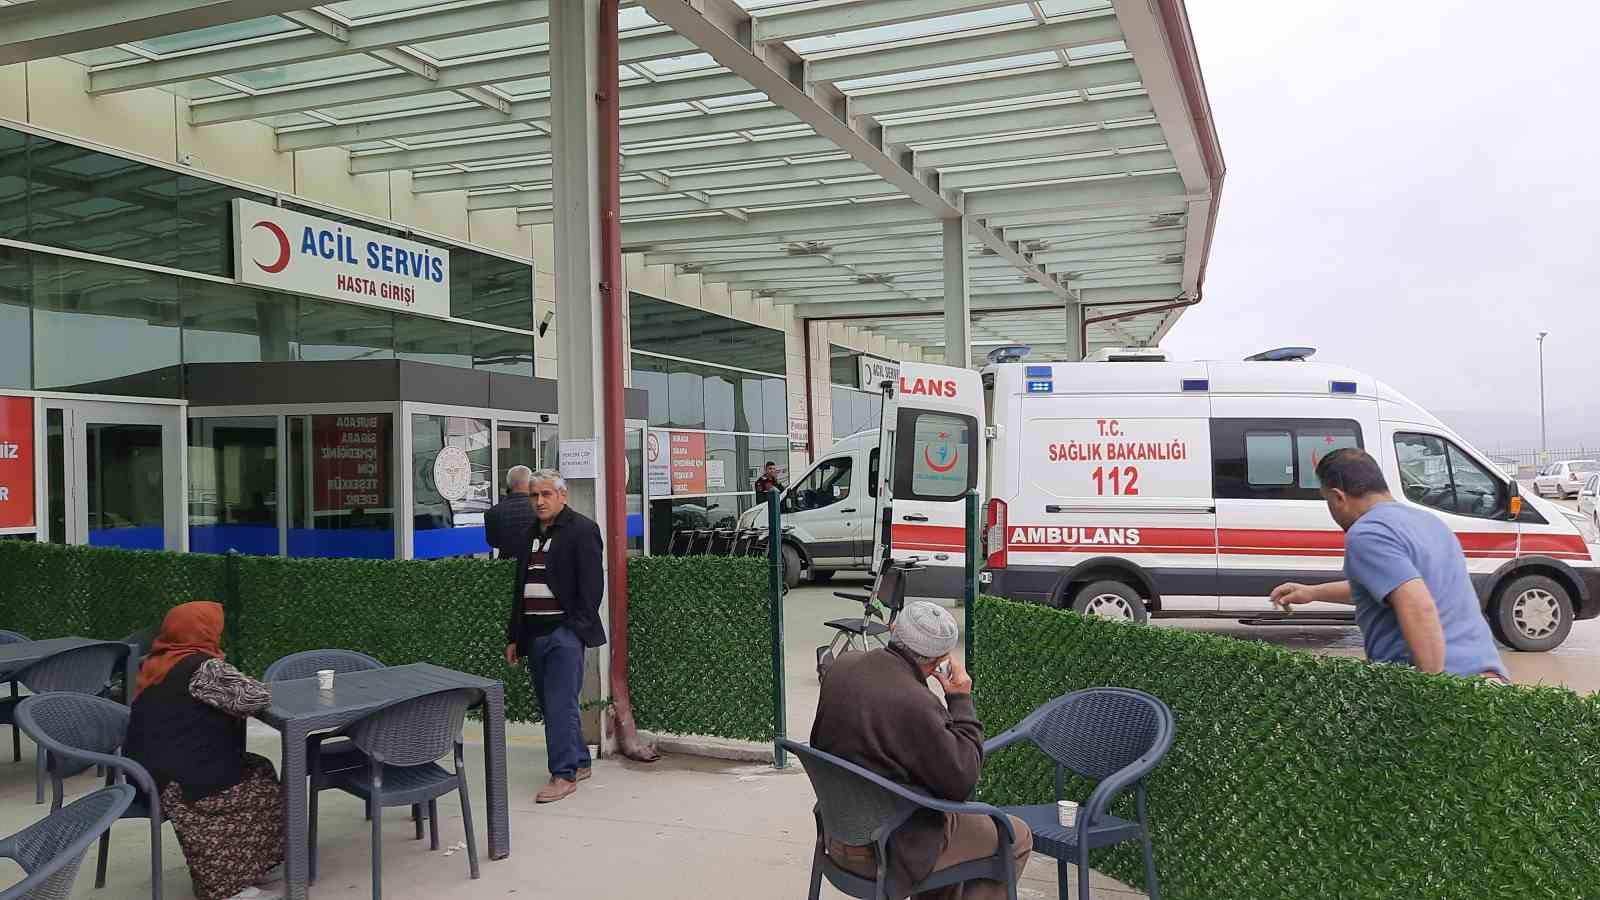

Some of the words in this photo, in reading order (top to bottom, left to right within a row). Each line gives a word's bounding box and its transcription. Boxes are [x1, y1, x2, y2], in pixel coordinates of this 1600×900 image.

[301, 226, 358, 265] ACİL
[366, 241, 443, 283] SERVİS
[337, 274, 377, 297] HASTA
[380, 282, 415, 306] GİRİŞİ
[900, 376, 957, 397] LANS
[1097, 419, 1124, 437] T.C.
[1049, 440, 1103, 461] SAĞLIK
[1107, 439, 1186, 461] BAKANLIĞI
[1092, 466, 1139, 495] 112
[1010, 527, 1140, 545] AMBULANS
